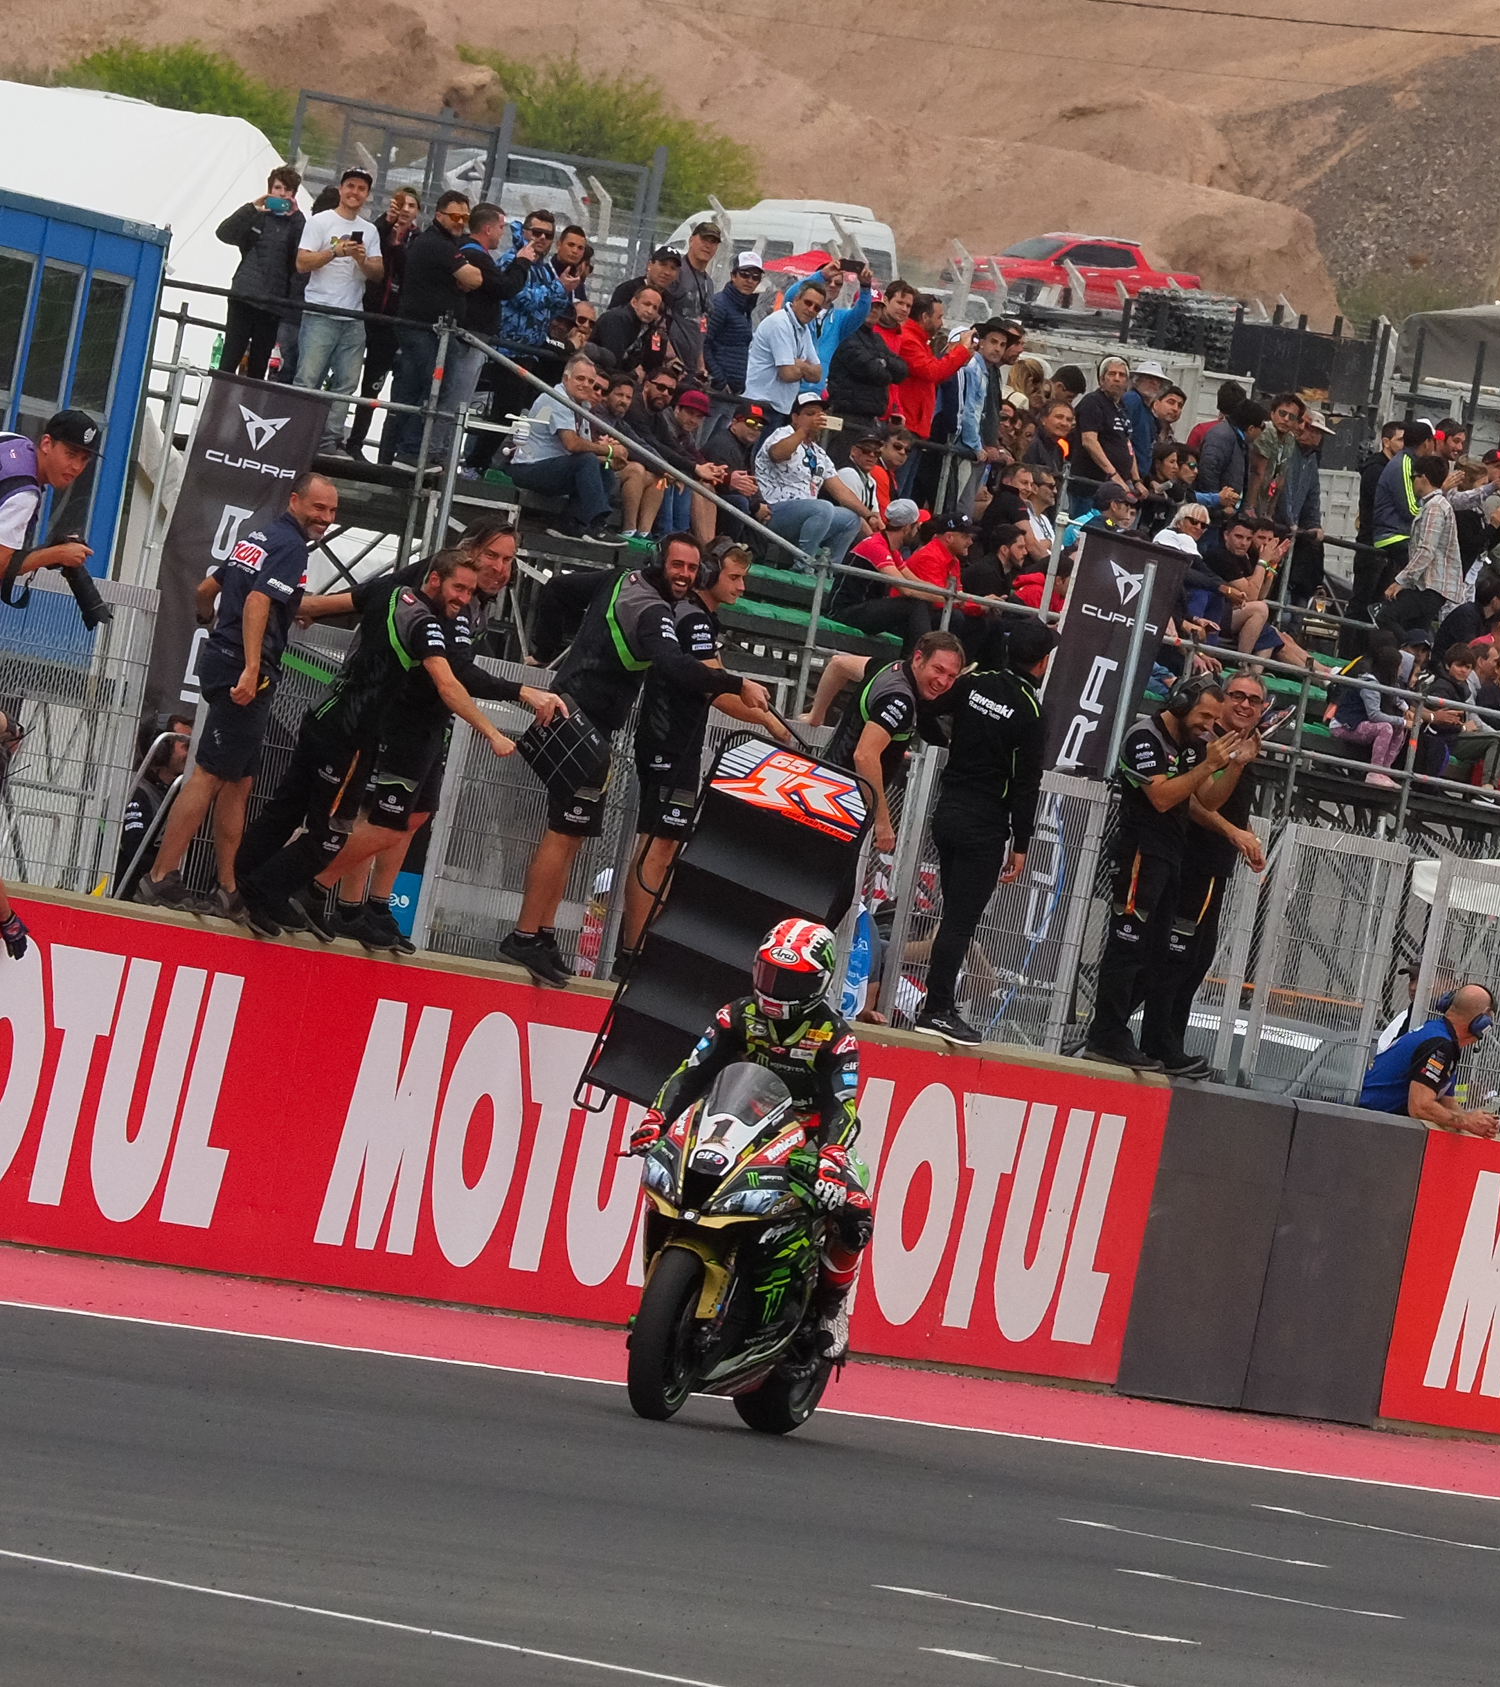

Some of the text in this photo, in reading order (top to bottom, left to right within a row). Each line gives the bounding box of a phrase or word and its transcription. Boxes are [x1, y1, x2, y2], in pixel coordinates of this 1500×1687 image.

[205, 449, 297, 480] CUPRA
[769, 754, 813, 774] 65
[772, 949, 796, 961] Arai
[314, 999, 659, 1288] MOTU
[847, 1078, 1127, 1345] OTUL
